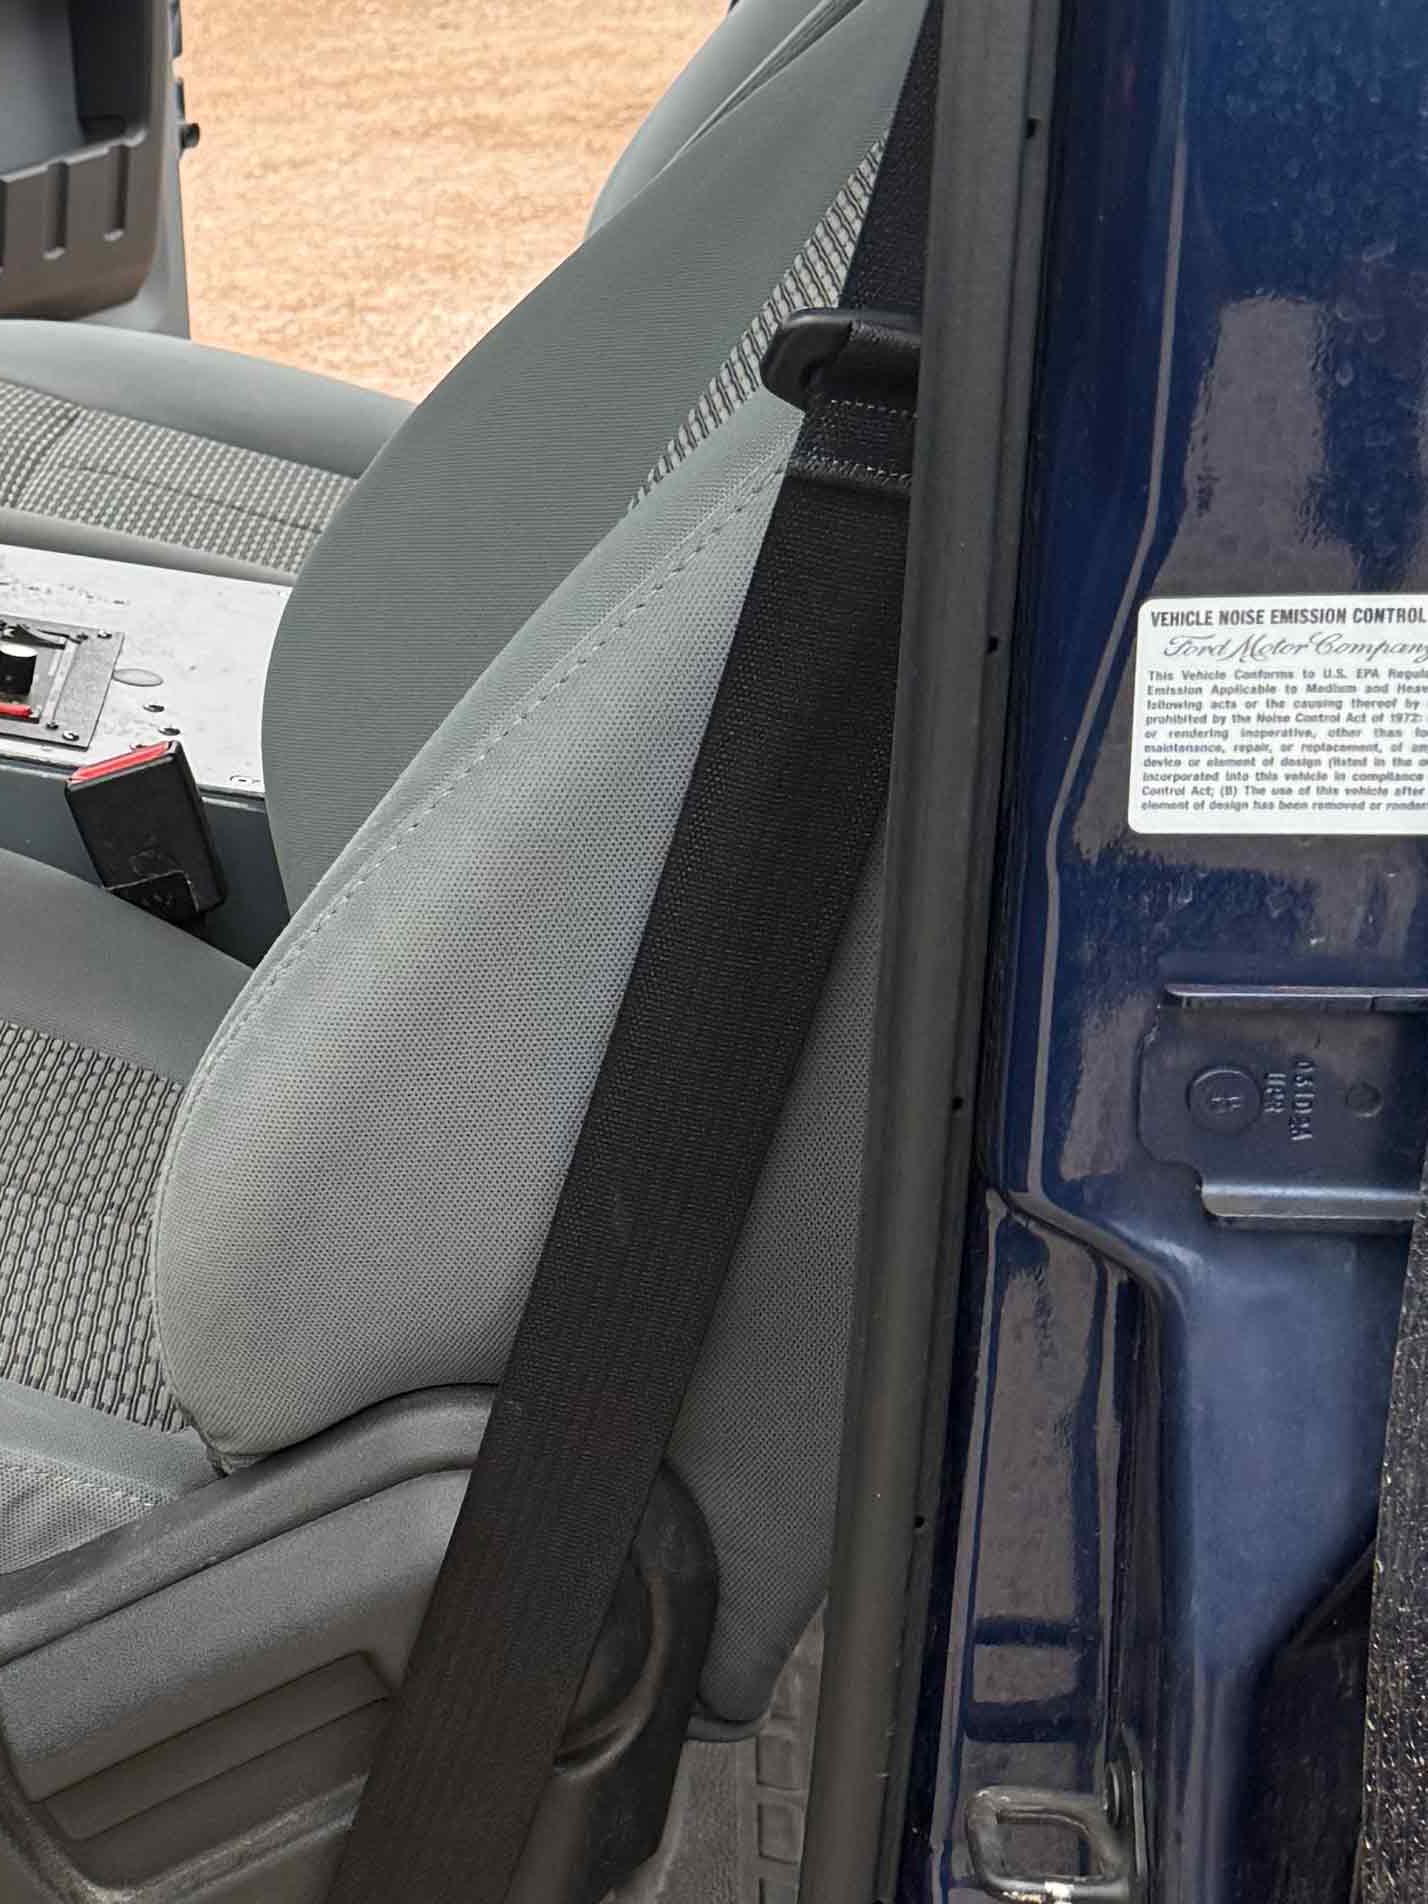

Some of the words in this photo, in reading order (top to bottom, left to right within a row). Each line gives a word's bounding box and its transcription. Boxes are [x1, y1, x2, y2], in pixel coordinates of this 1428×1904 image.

[1150, 610, 1214, 627] VEHICLE
[1218, 608, 1265, 625] NOISE
[1270, 608, 1347, 624] EMISSION
[1352, 607, 1427, 624] CONTROL
[1163, 633, 1233, 657] Ford
[1216, 633, 1309, 663] Motor
[1149, 670, 1175, 681] This
[1181, 670, 1227, 681] Vehicle
[1235, 669, 1294, 680] Conforms
[1303, 669, 1315, 679] to
[1356, 668, 1380, 679] EPA
[1147, 685, 1203, 696] Emission
[1211, 684, 1277, 697] Applicable
[1286, 684, 1298, 694] to
[1305, 684, 1357, 694] Medium
[1365, 683, 1389, 694] and
[1147, 699, 1203, 711] following
[1210, 699, 1237, 710] acts
[1245, 700, 1258, 709] or
[1265, 698, 1285, 709] the
[1293, 699, 1343, 710] causing
[1351, 698, 1396, 709] thereof
[1145, 714, 1207, 726] prohibited
[1211, 714, 1226, 725] by
[1231, 713, 1252, 724] the
[1256, 713, 1291, 724] Noise
[1295, 713, 1341, 723] Control
[1345, 712, 1366, 723] Act
[1371, 712, 1384, 723] of
[1169, 728, 1229, 741] rendering
[1327, 728, 1362, 737] other
[1144, 743, 1226, 754] maintenance,
[1143, 757, 1181, 767] device
[1142, 786, 1186, 796] Control
[1244, 785, 1267, 796] The
